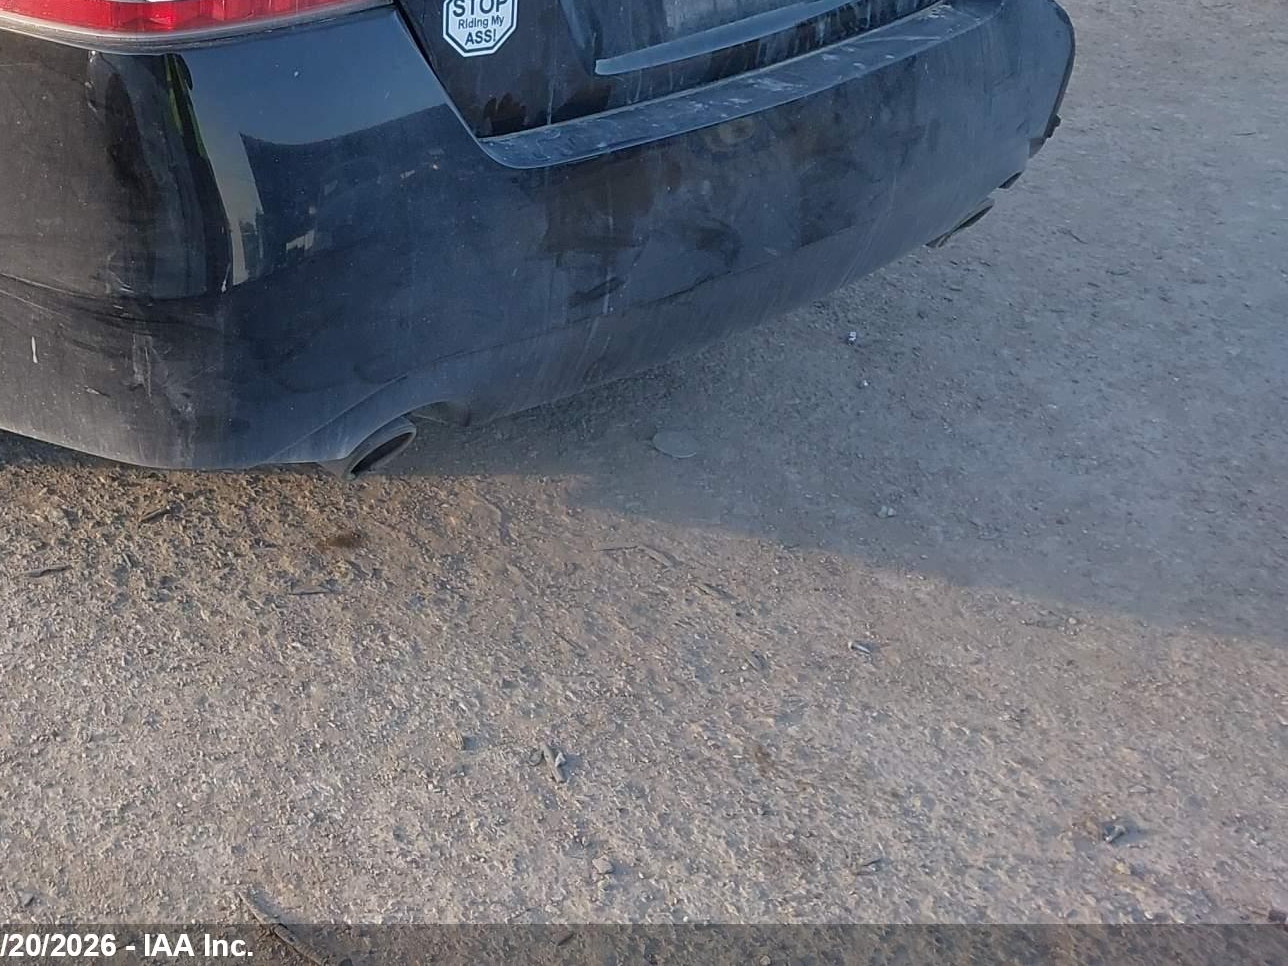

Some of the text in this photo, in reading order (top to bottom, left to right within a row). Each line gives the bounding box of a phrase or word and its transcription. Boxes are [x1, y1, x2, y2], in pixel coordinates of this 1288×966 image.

[458, 16, 505, 29] Riding My
[465, 29, 496, 46] ASS!
